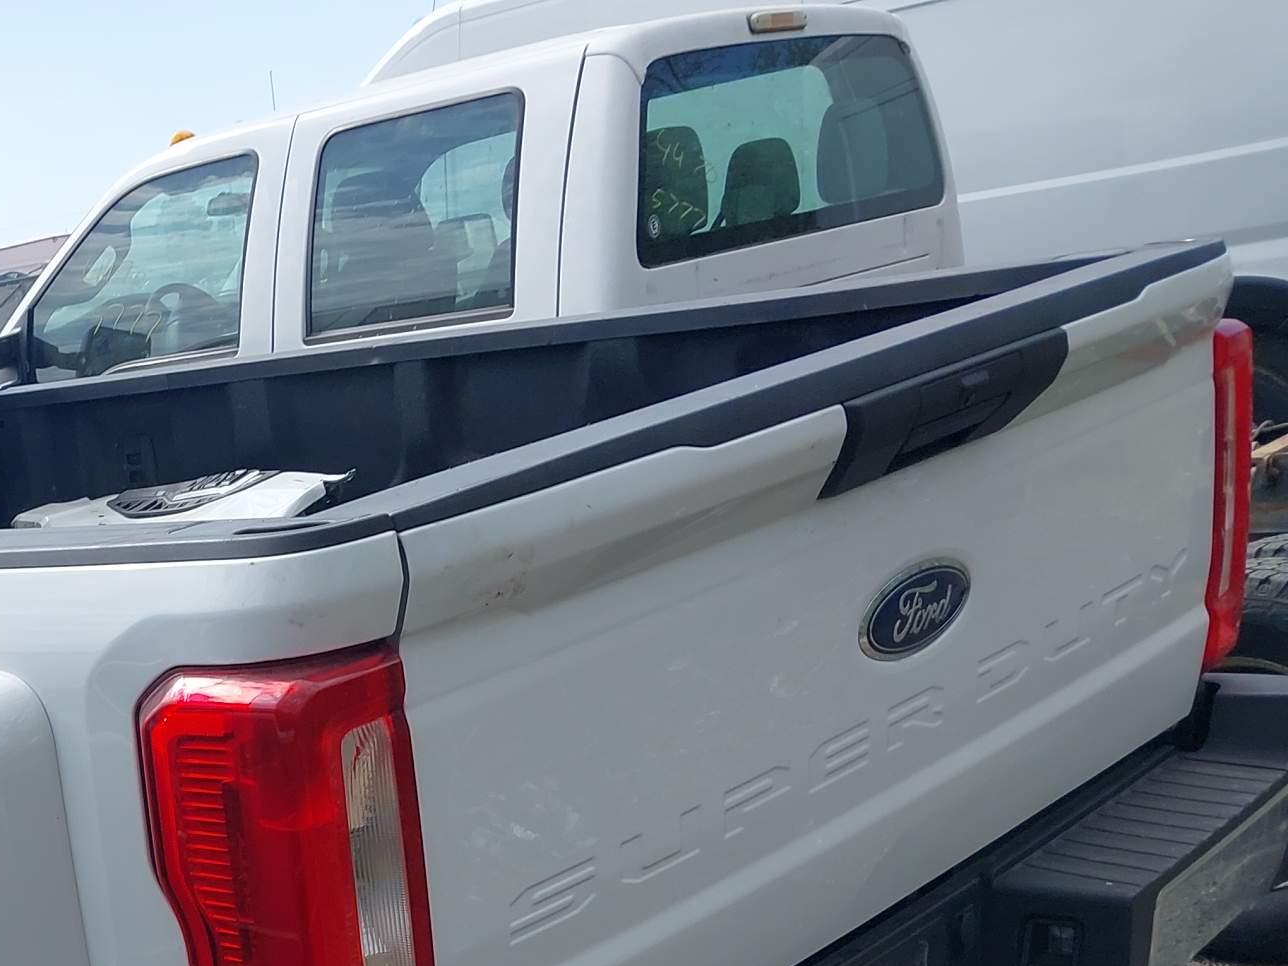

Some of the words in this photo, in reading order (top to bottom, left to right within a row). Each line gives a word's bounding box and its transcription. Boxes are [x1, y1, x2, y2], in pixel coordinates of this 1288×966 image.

[893, 580, 952, 643] Ford
[510, 684, 945, 946] SUPER
[975, 547, 1187, 705] DUTY
